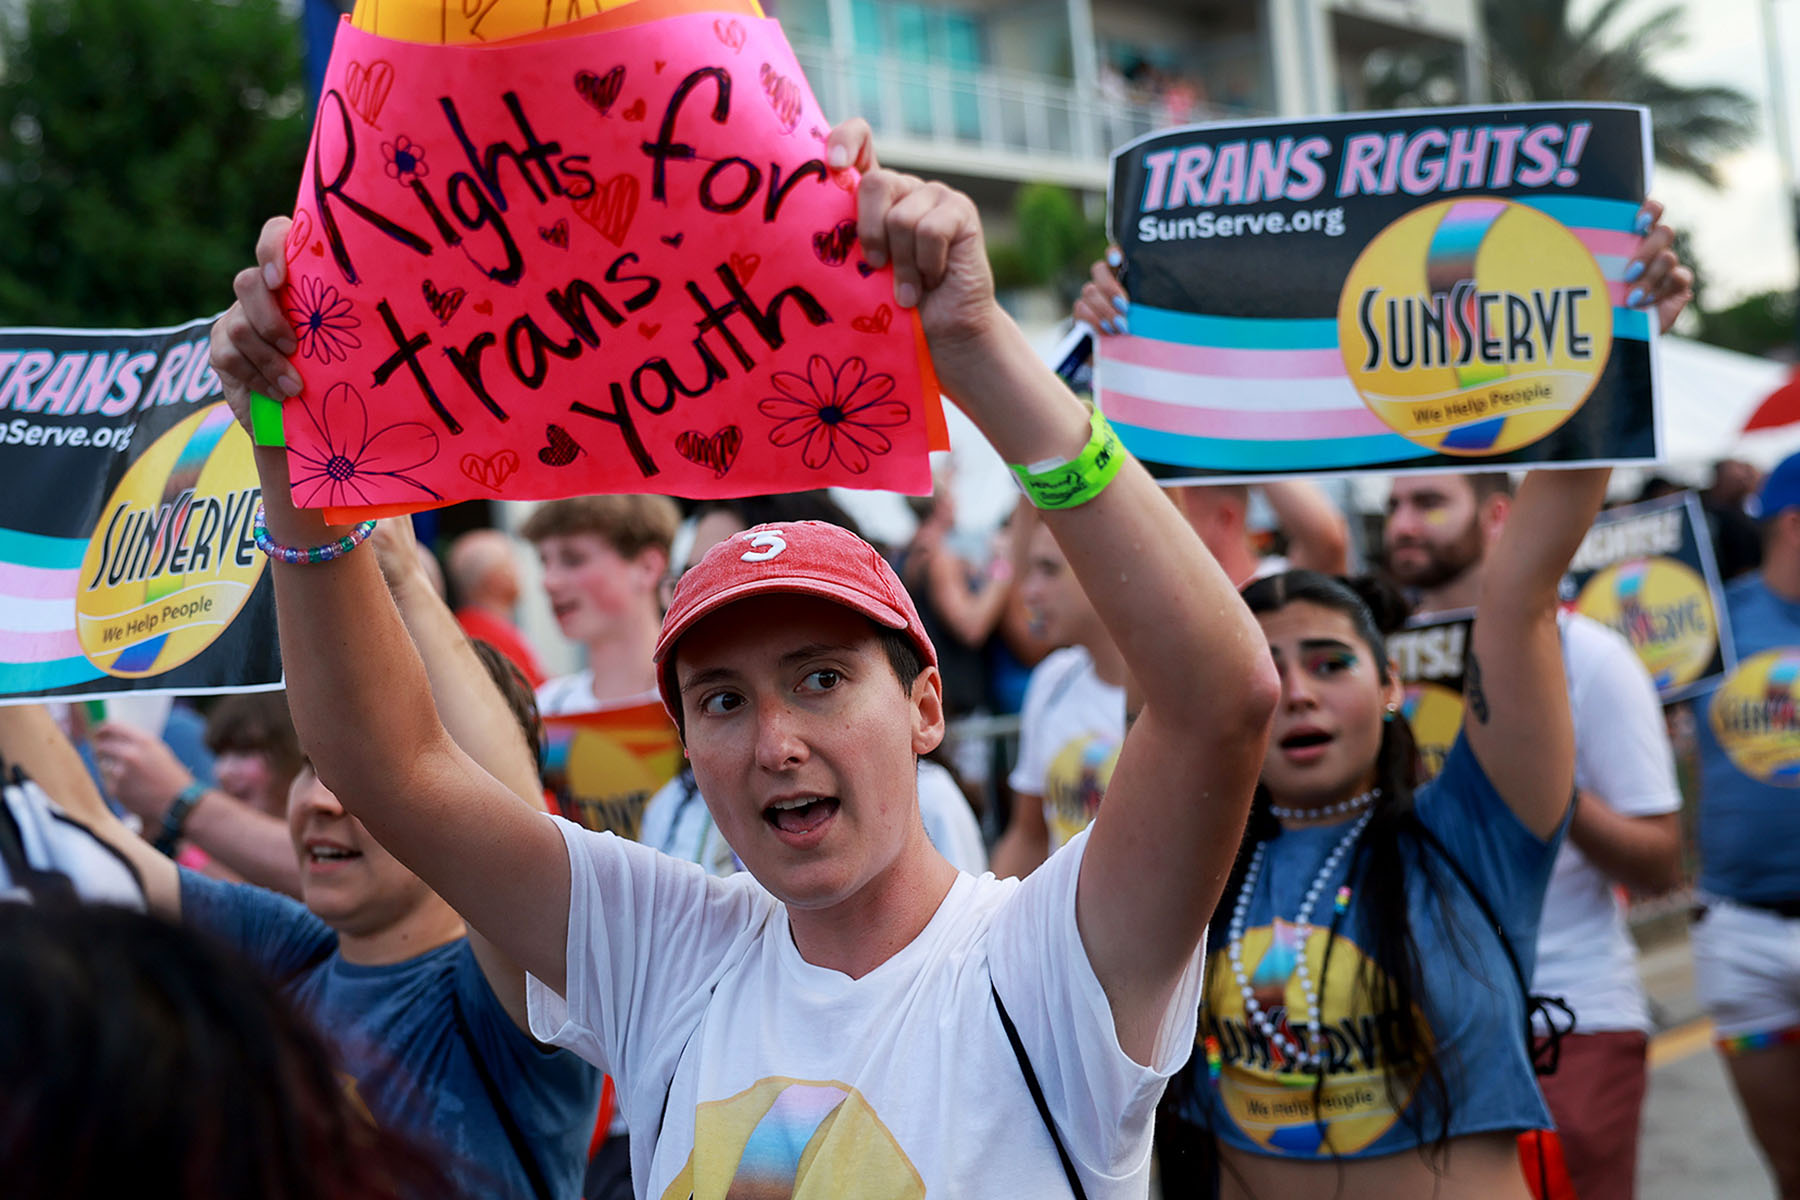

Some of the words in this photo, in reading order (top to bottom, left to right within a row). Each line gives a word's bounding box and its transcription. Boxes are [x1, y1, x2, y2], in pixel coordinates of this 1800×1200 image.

[314, 89, 596, 286] Rights
[642, 66, 827, 222] for
[1140, 135, 1332, 213] TRANS
[1336, 121, 1592, 199] RIGHTS!
[1138, 207, 1345, 242] SunServe.org
[138, 337, 223, 412] RIG
[371, 252, 660, 435] trans
[571, 262, 834, 477] youth
[1413, 409, 1442, 424] We
[1445, 399, 1487, 420] Help
[1489, 384, 1553, 409] People
[741, 530, 787, 562] 3
[103, 627, 123, 643] We
[126, 614, 158, 635] Help
[162, 596, 213, 623] People
